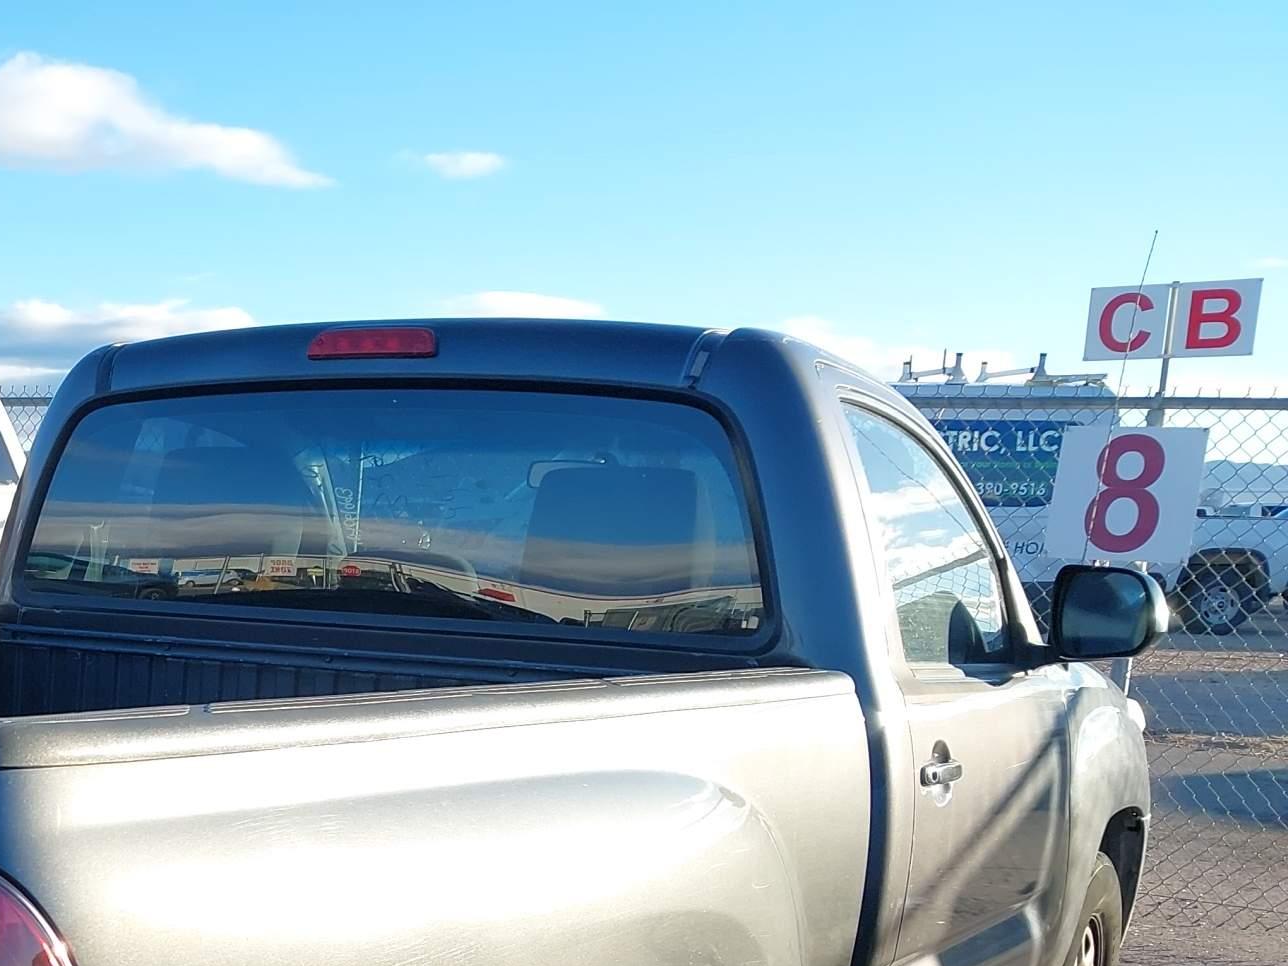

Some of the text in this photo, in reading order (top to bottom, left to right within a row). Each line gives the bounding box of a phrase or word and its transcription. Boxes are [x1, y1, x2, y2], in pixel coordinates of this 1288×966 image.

[1098, 291, 1154, 353] C
[1184, 287, 1243, 350] B
[939, 430, 1060, 455] TRIC, LLC
[1084, 432, 1166, 554] 8
